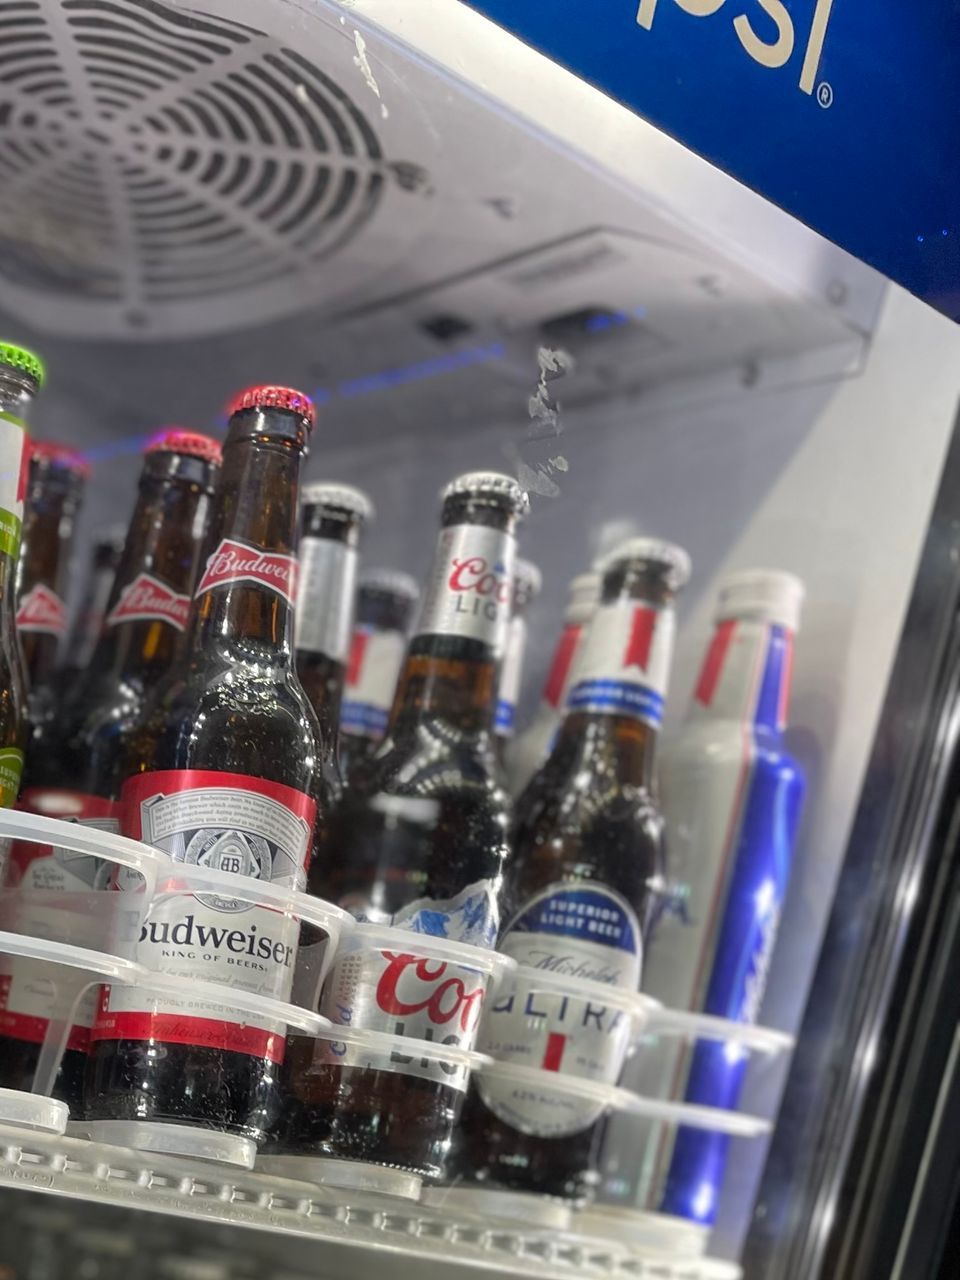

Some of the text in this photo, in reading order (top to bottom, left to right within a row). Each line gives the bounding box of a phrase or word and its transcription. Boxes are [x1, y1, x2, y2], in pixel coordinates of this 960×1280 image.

[550, 900, 620, 922] SUPERIOR
[541, 912, 622, 938] LIGHT BEER
[162, 950, 220, 962] KING OF
